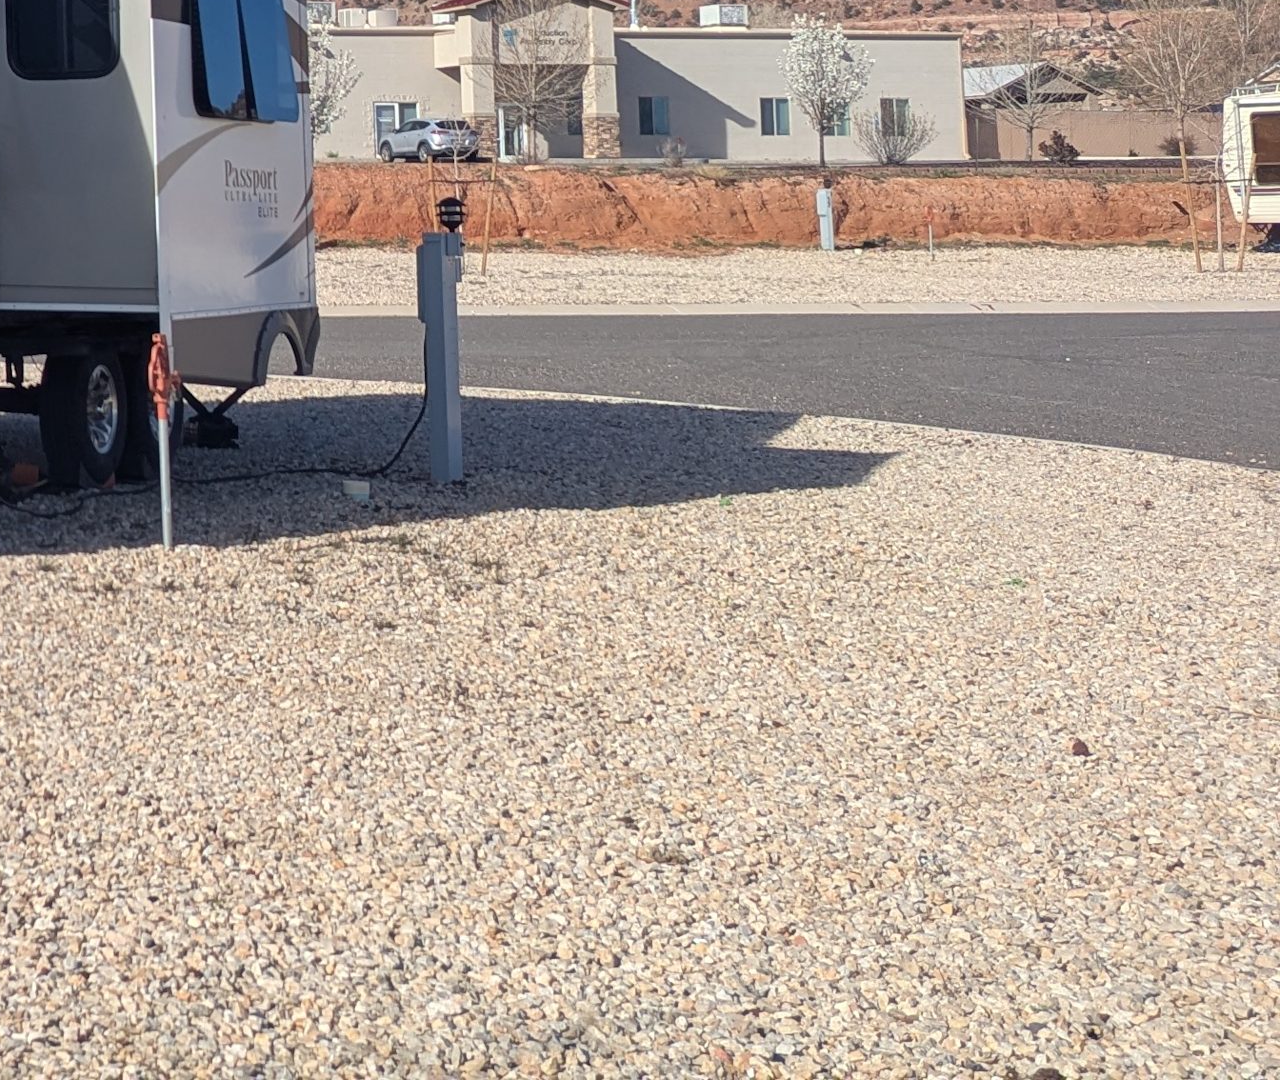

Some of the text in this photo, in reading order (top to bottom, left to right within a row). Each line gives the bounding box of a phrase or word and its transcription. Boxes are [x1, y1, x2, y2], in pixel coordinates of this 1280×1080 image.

[224, 159, 278, 195] Passport
[224, 190, 278, 204] ULTRA LITE
[257, 206, 278, 218] ELITE
